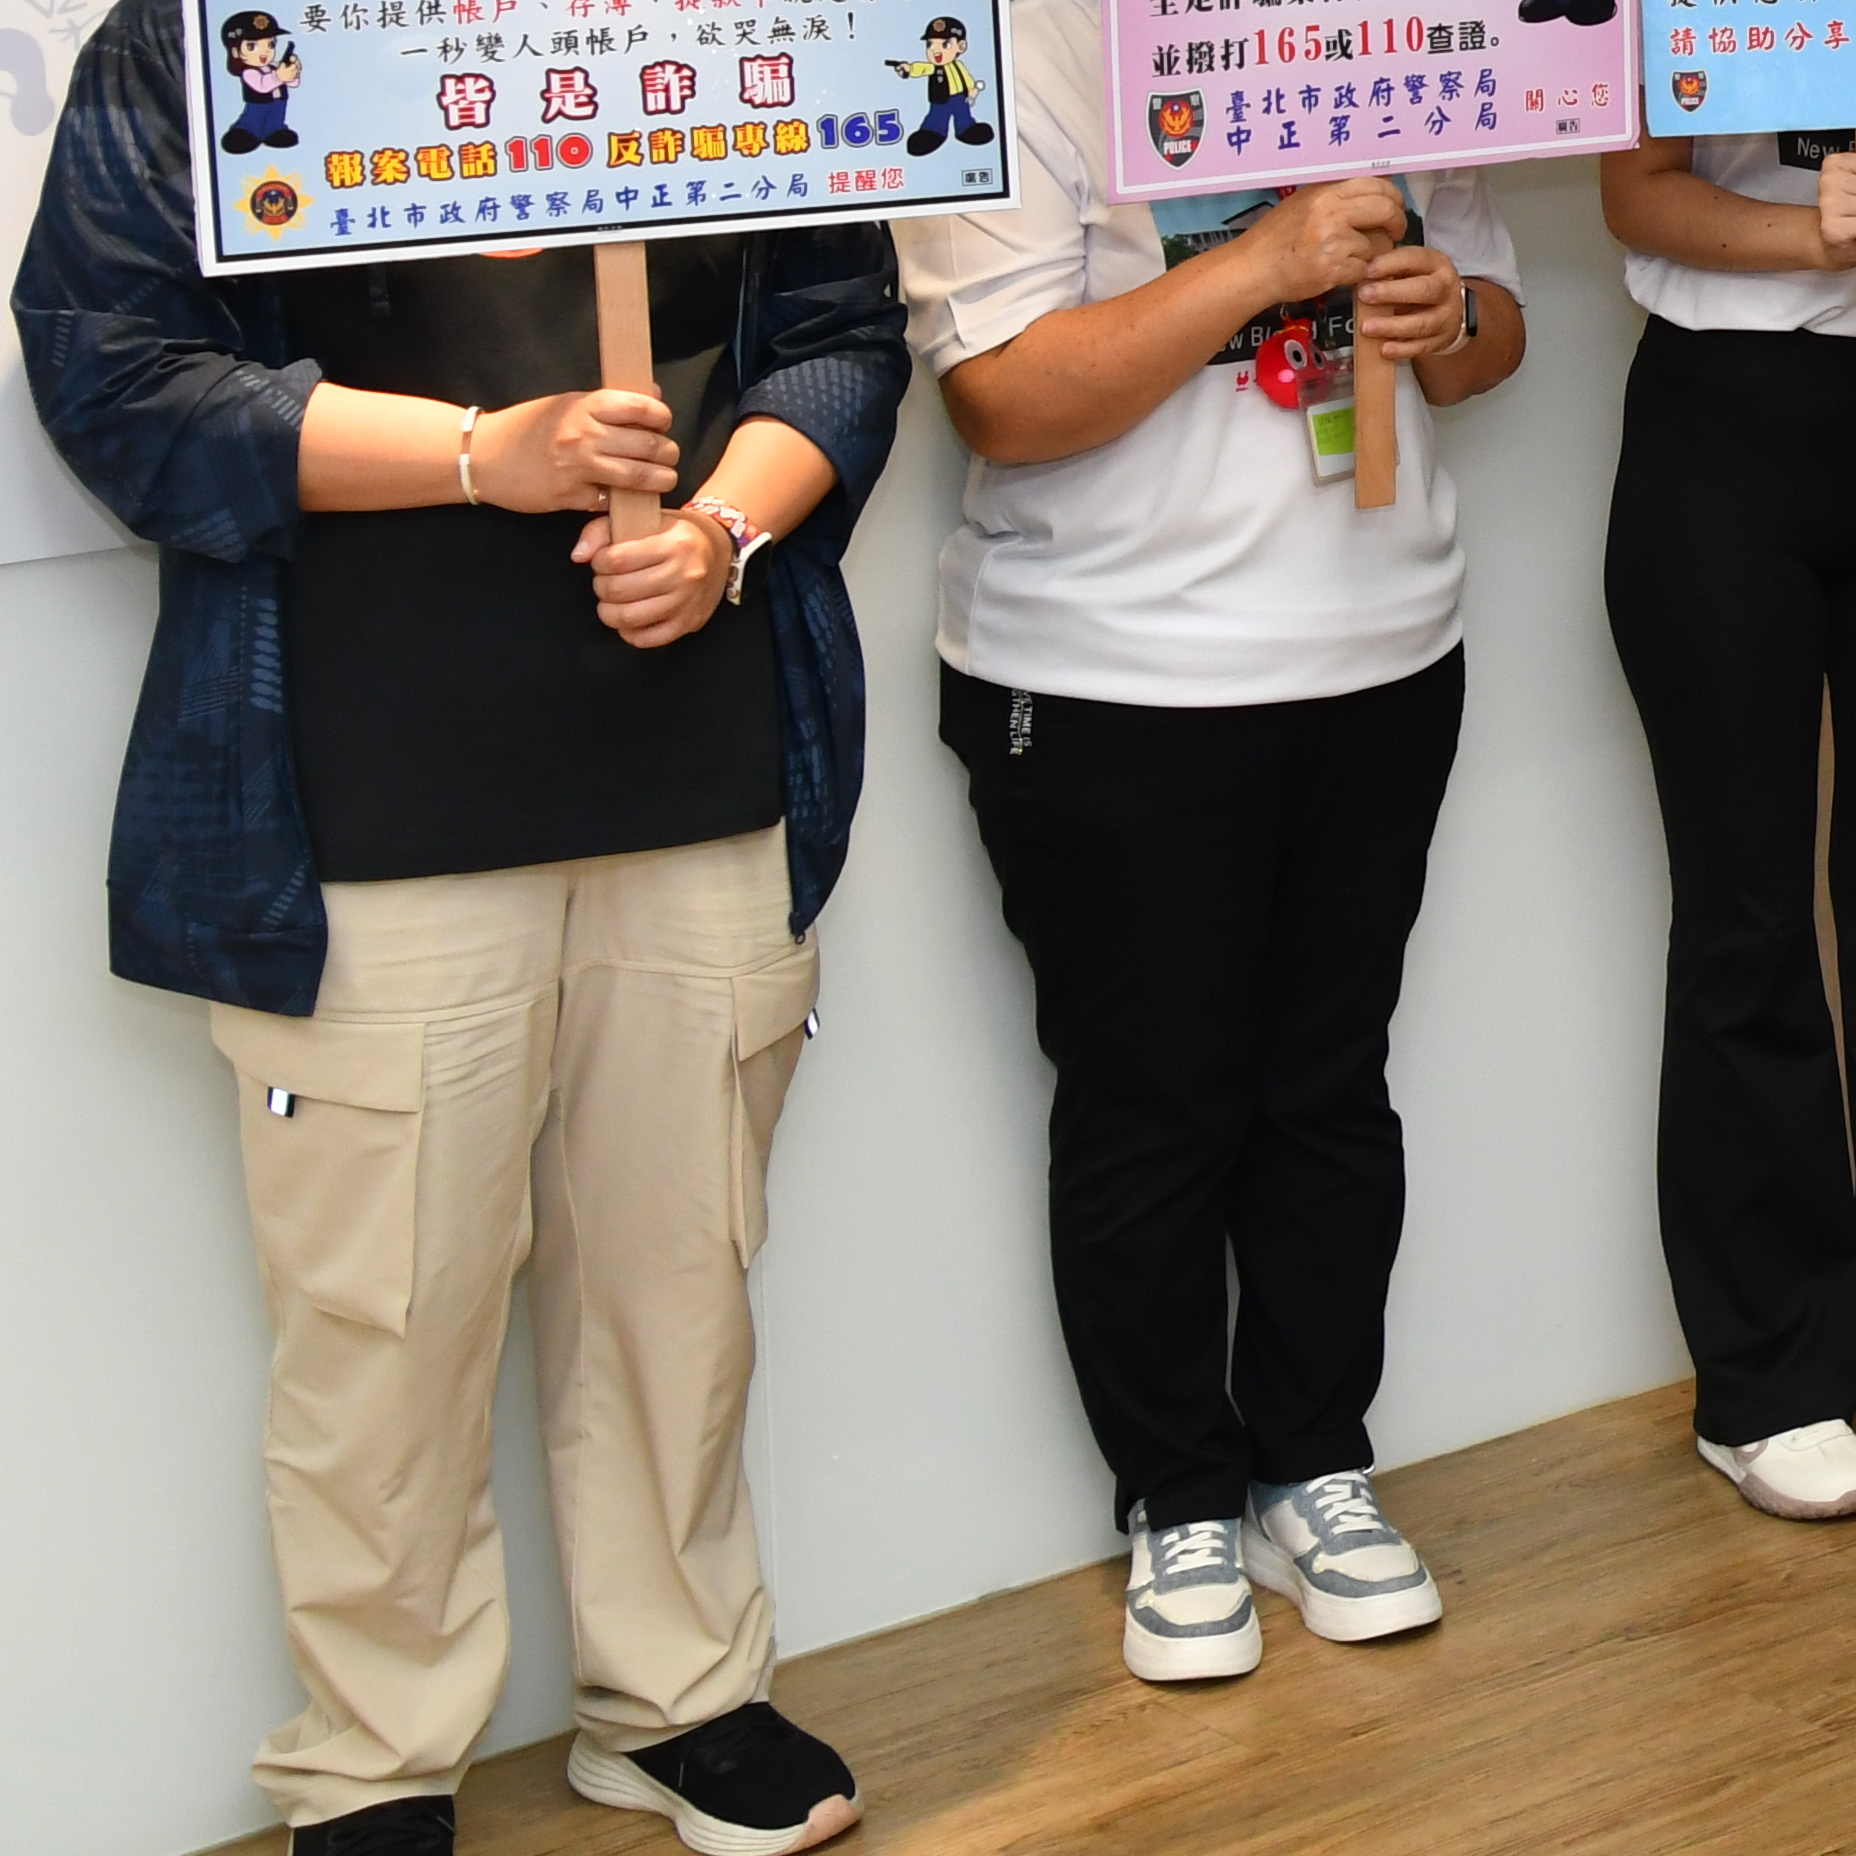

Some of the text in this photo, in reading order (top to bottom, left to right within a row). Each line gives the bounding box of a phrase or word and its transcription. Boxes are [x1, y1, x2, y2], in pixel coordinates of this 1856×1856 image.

[400, 13, 859, 65] 一秒變人頭帳戶，欲哭無淚！
[1152, 15, 1501, 77] 並撥打165或110查證。
[440, 52, 797, 131] 皆是詐騙
[1225, 68, 1498, 124] 臺北市政府警察局
[1525, 82, 1610, 113] 關心您
[1164, 140, 1192, 155] POLICE
[1226, 101, 1498, 155] 中正第二分局
[329, 168, 907, 238] 臺北市政府警察局中正第二分局 提醒您
